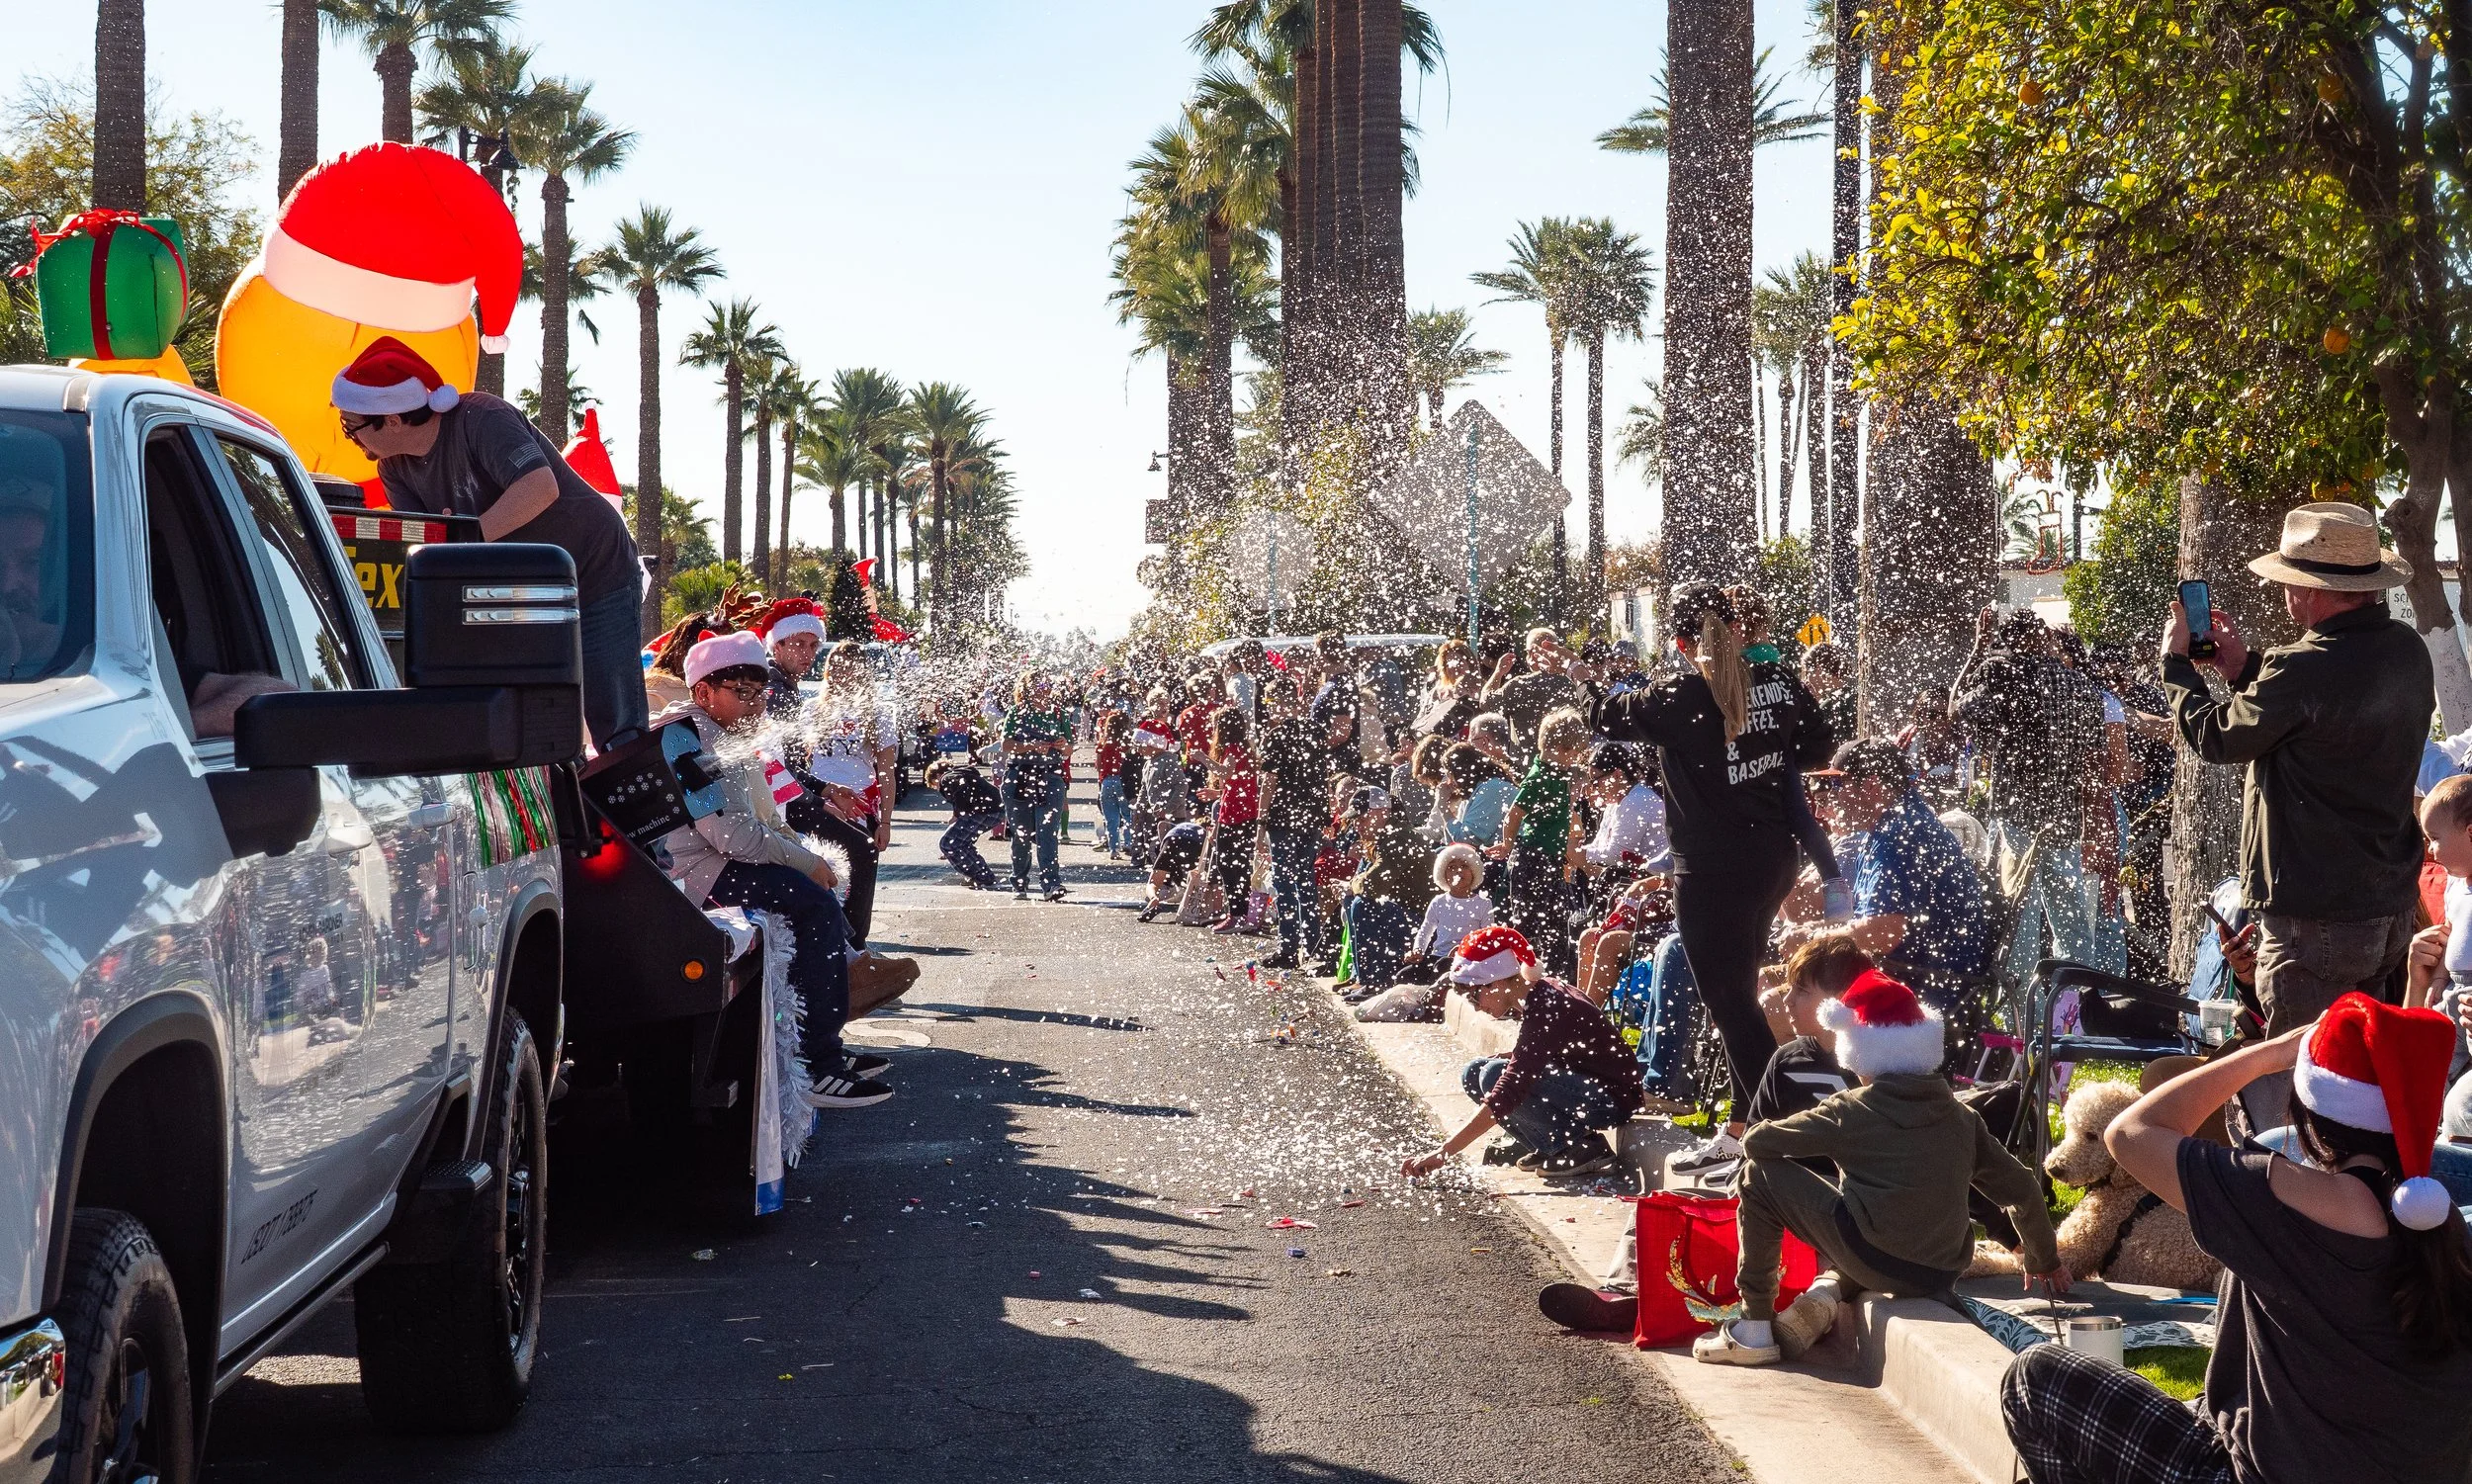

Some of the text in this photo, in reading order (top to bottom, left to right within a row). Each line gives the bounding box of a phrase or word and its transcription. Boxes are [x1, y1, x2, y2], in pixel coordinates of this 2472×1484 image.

[2401, 608, 2415, 619] ZO
[1726, 742, 1739, 761] &
[638, 814, 670, 835] machine
